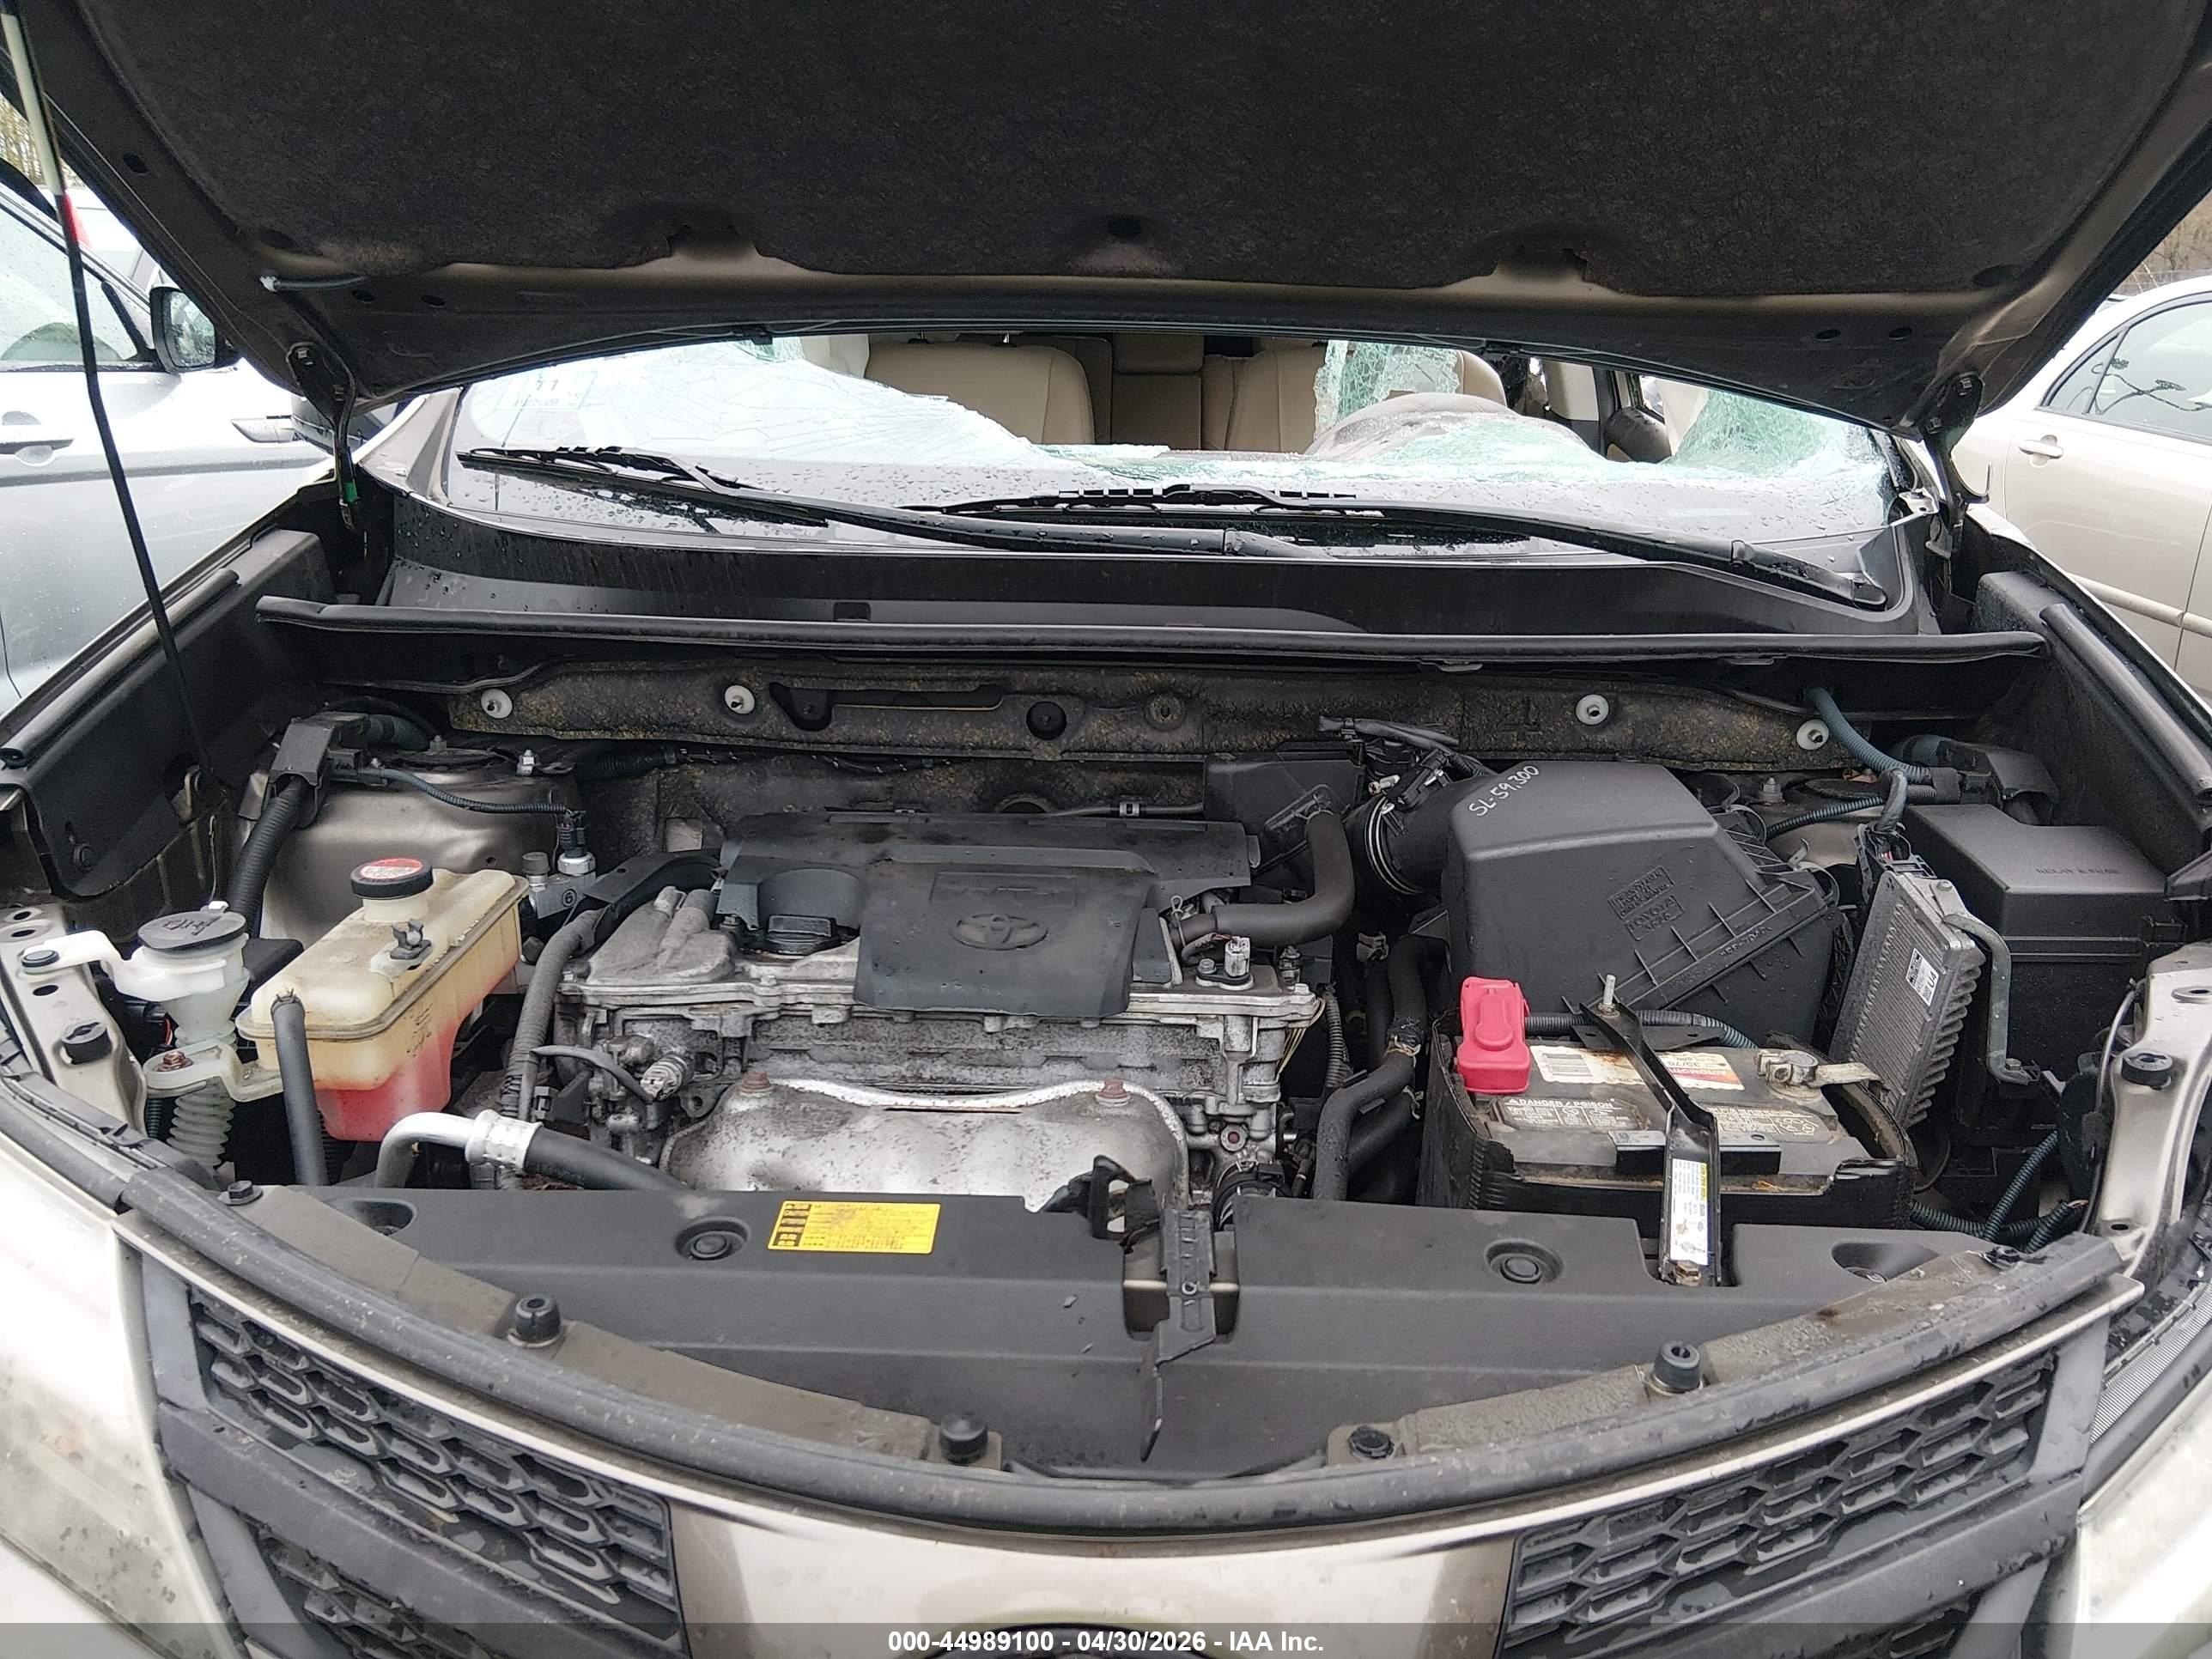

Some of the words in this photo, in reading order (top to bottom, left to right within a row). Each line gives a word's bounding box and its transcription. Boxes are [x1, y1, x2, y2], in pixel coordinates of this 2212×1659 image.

[1468, 765, 1540, 817] SL-59,300
[1627, 896, 1678, 931] TOYOTA
[1927, 970, 1937, 988] U4
